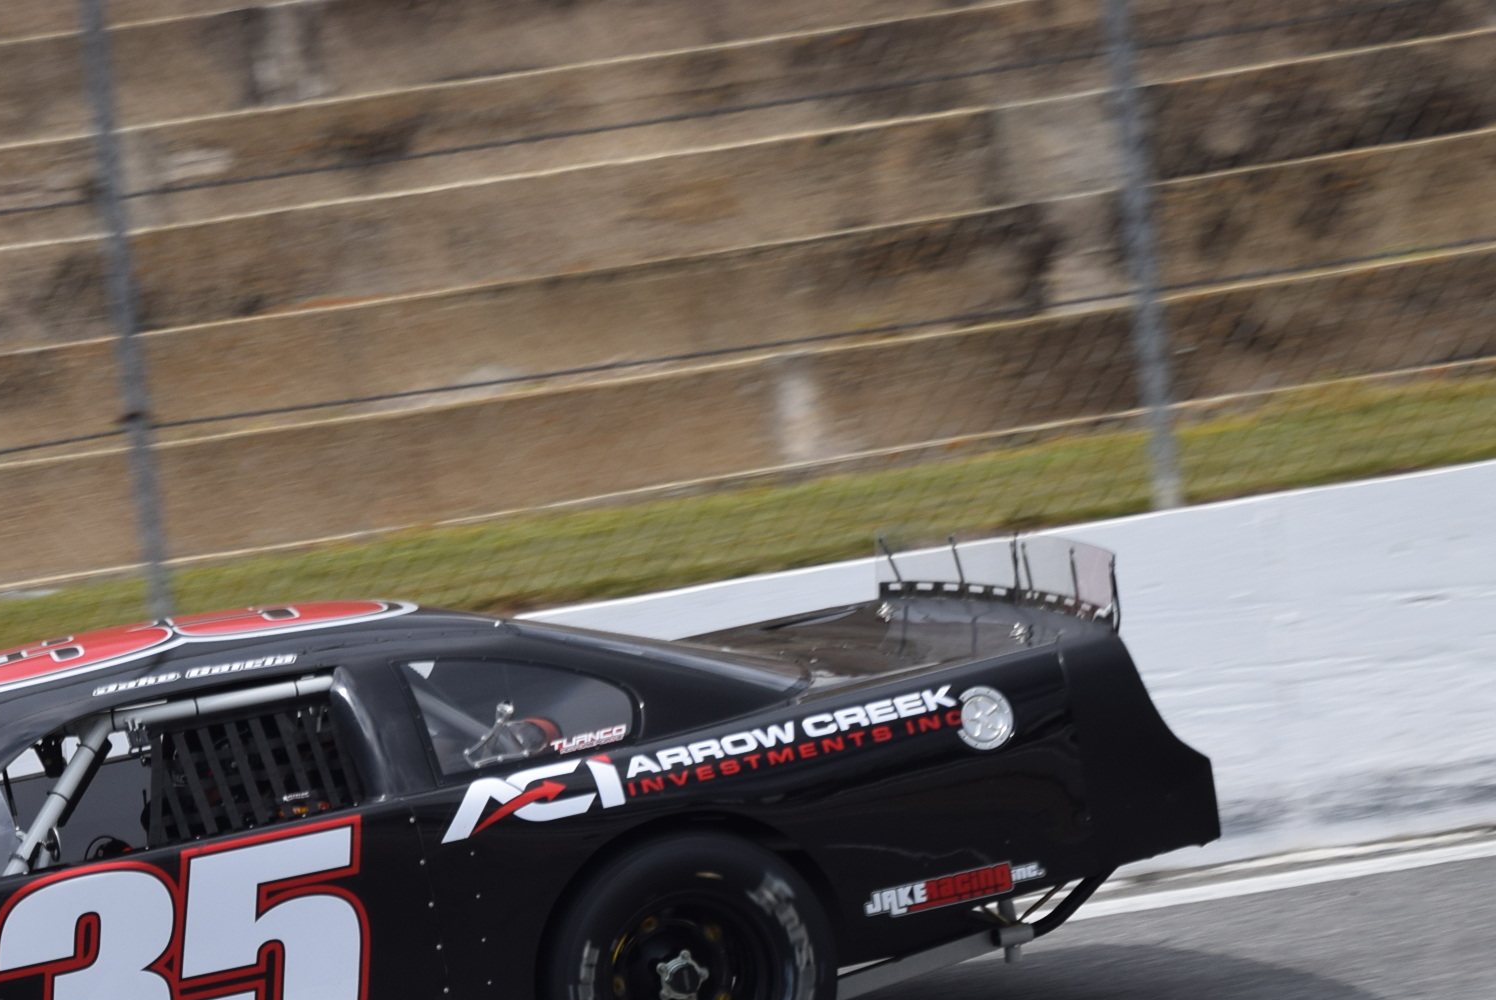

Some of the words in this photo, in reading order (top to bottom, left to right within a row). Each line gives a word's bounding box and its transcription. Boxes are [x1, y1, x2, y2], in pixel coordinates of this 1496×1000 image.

[626, 721, 795, 778] ARROW
[802, 685, 957, 738] CREEK
[627, 725, 893, 797] INVESTMENTS
[905, 709, 962, 736] INC
